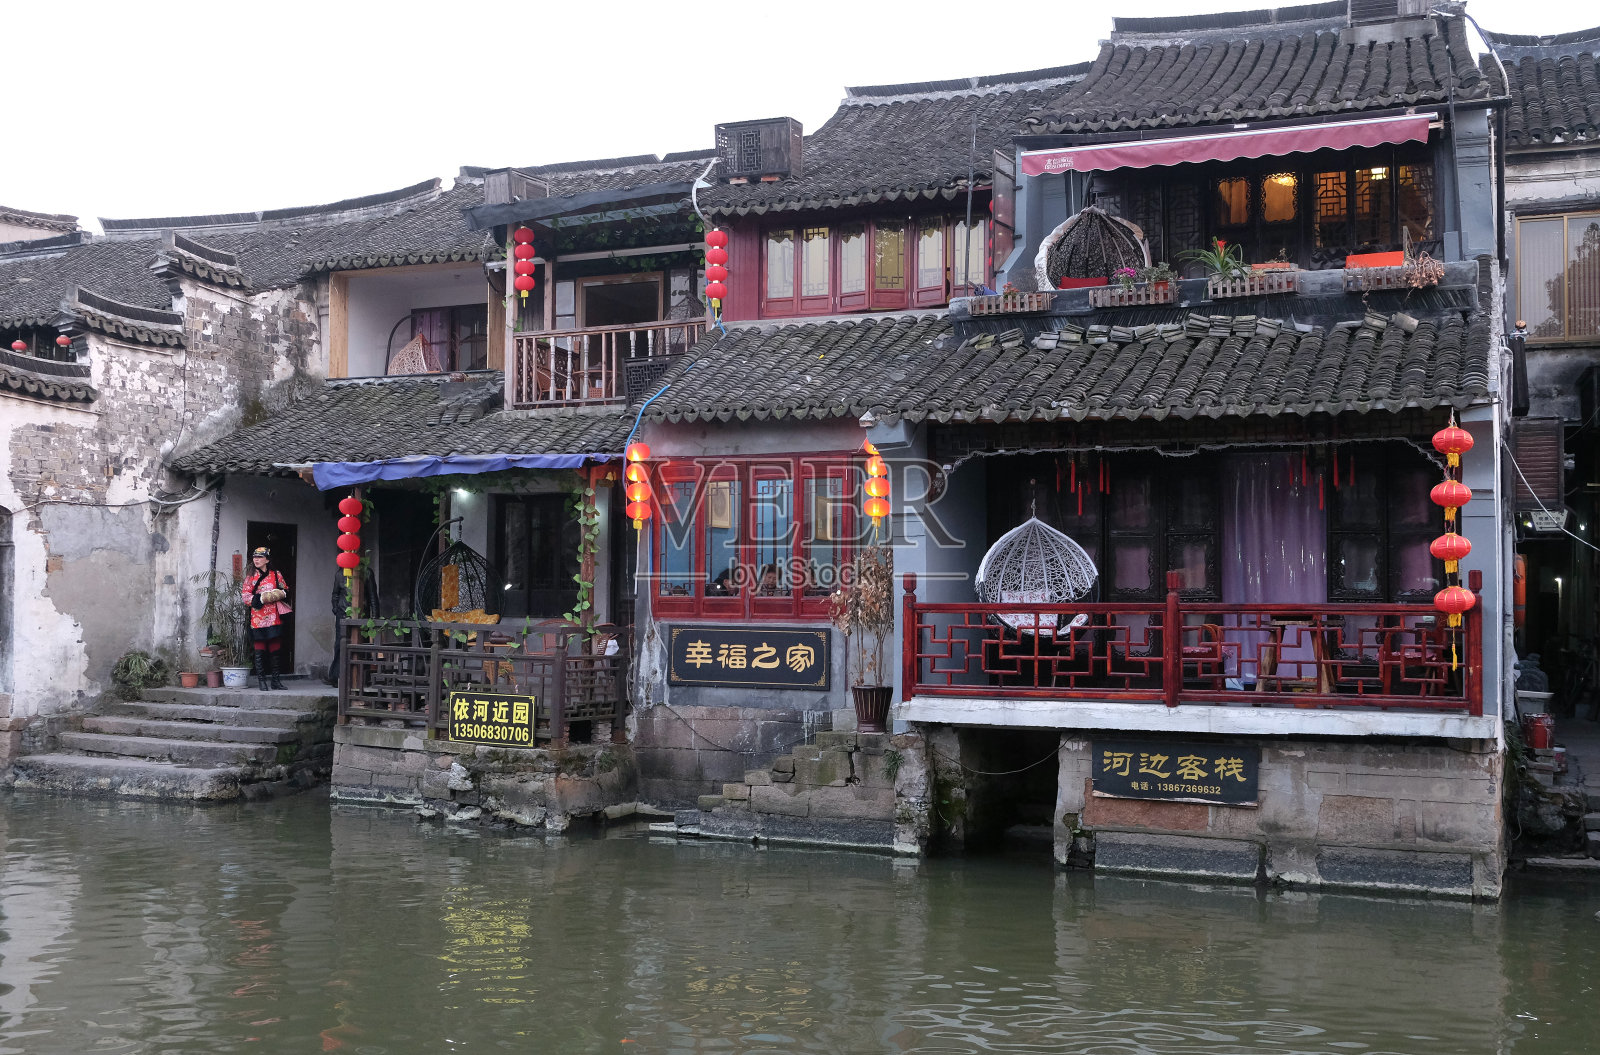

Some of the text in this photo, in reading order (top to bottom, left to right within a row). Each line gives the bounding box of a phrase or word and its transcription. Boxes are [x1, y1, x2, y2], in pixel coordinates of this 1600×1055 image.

[685, 639, 815, 673] 幸福之家
[453, 697, 529, 724] 依河近园
[454, 723, 529, 742] 13506830706
[1103, 750, 1247, 782] 河边客栈
